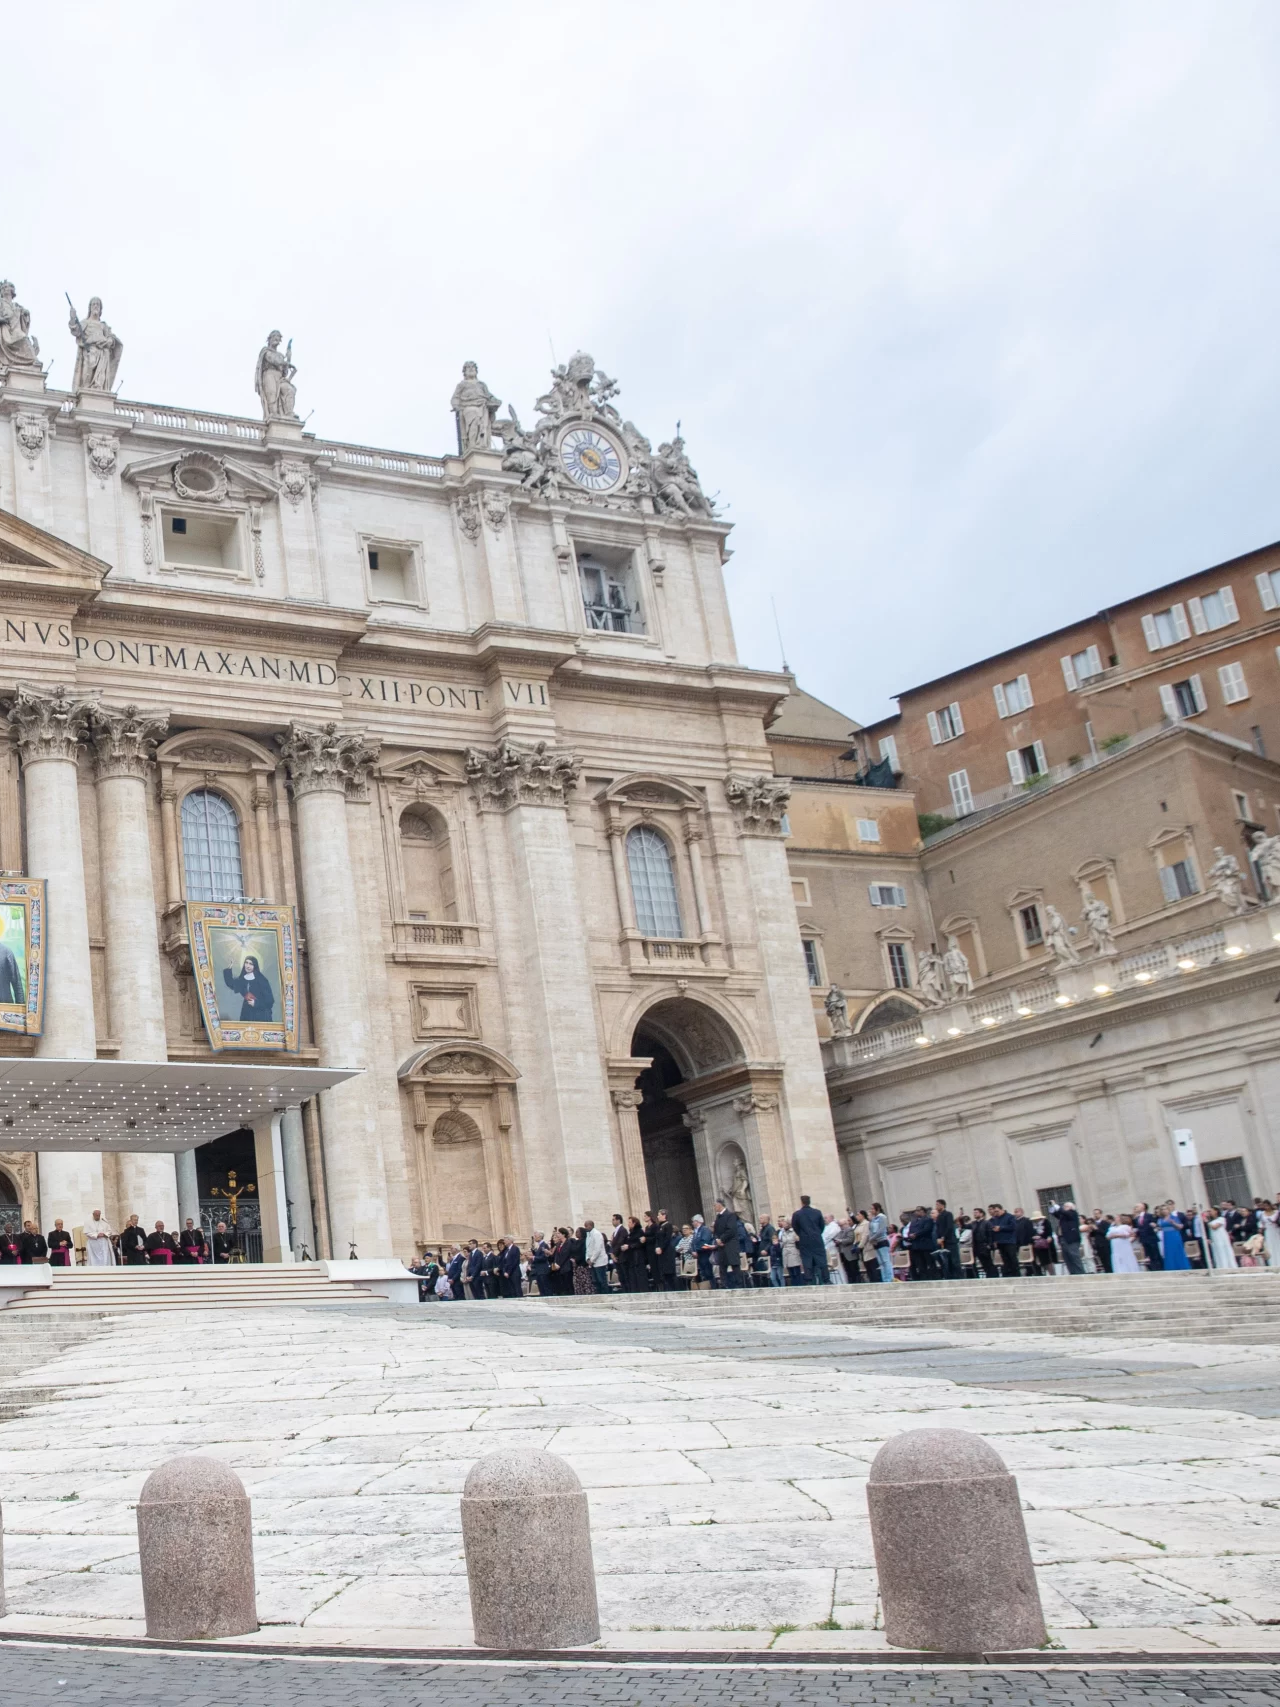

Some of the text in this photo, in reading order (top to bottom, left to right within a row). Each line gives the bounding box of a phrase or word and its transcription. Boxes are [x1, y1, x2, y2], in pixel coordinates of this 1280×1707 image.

[74, 636, 160, 667] PONT
[164, 645, 234, 675] MAX
[240, 655, 281, 680] AN
[408, 682, 485, 711] PONT
[505, 681, 548, 705] VII
